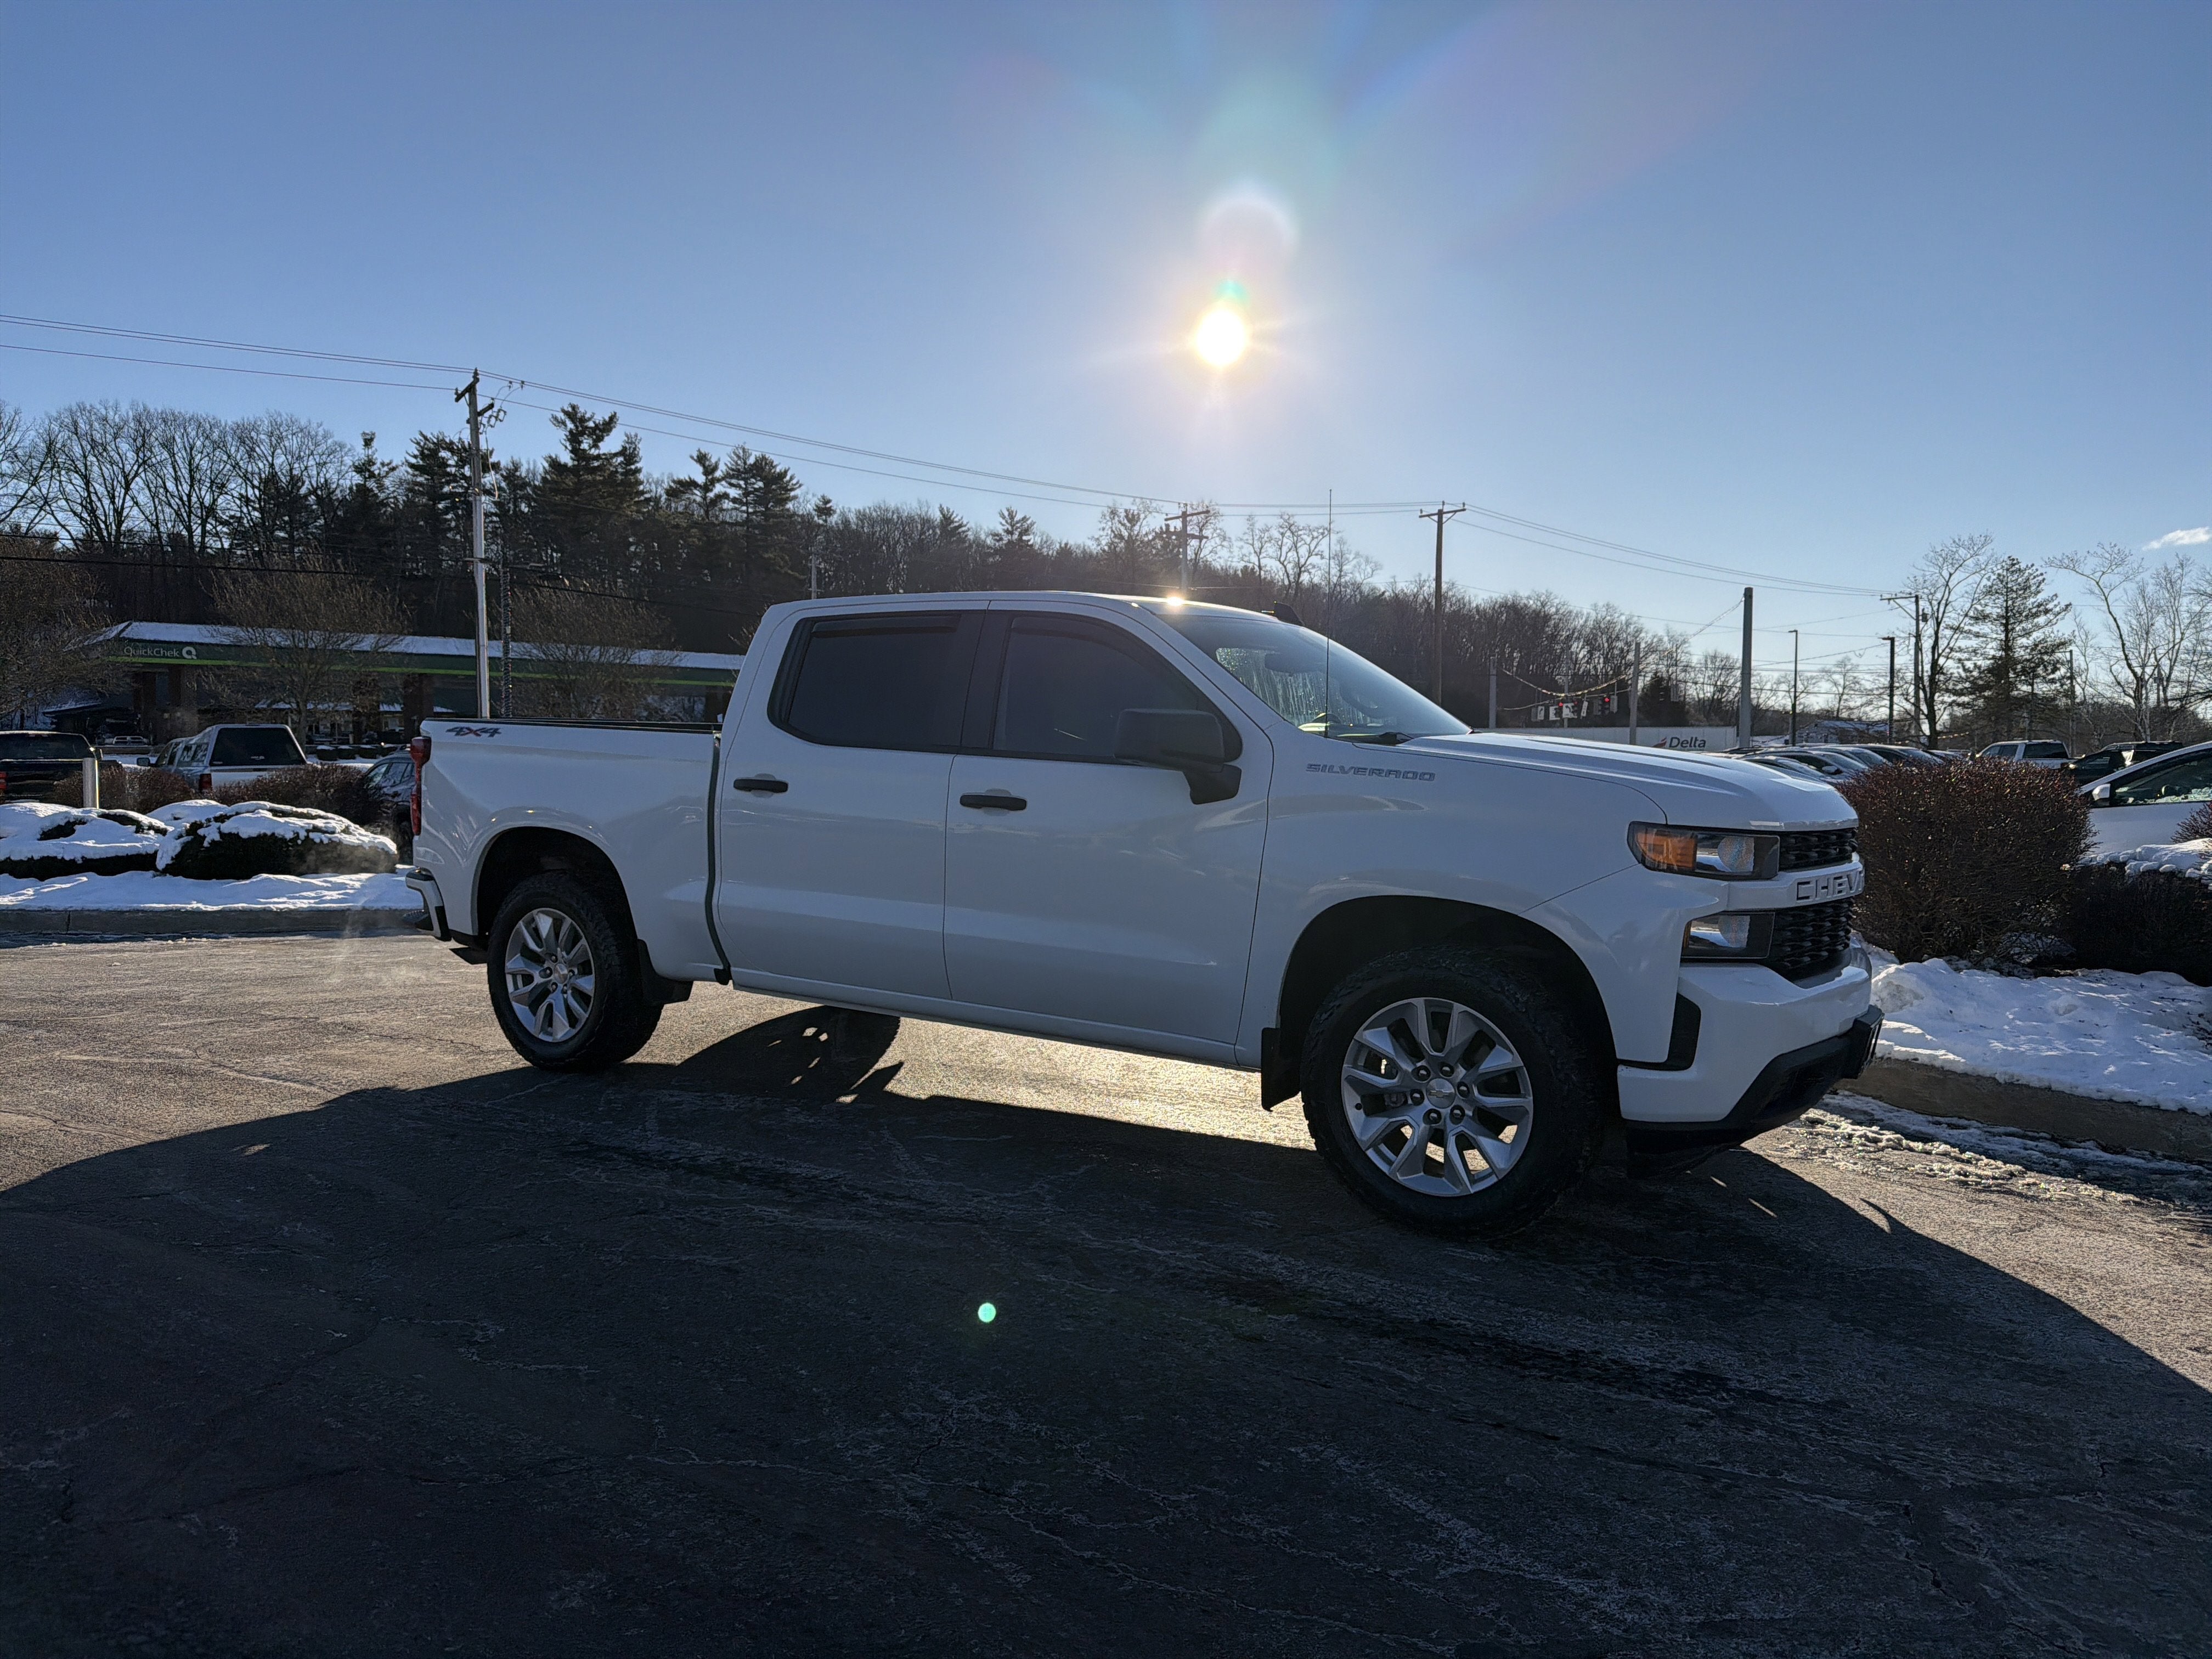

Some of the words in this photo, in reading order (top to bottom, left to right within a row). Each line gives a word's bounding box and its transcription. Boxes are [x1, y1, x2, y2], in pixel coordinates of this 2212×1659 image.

[123, 646, 180, 657] QuickChek
[1669, 736, 1706, 748] Delta
[1306, 763, 1436, 781] SILVERADO
